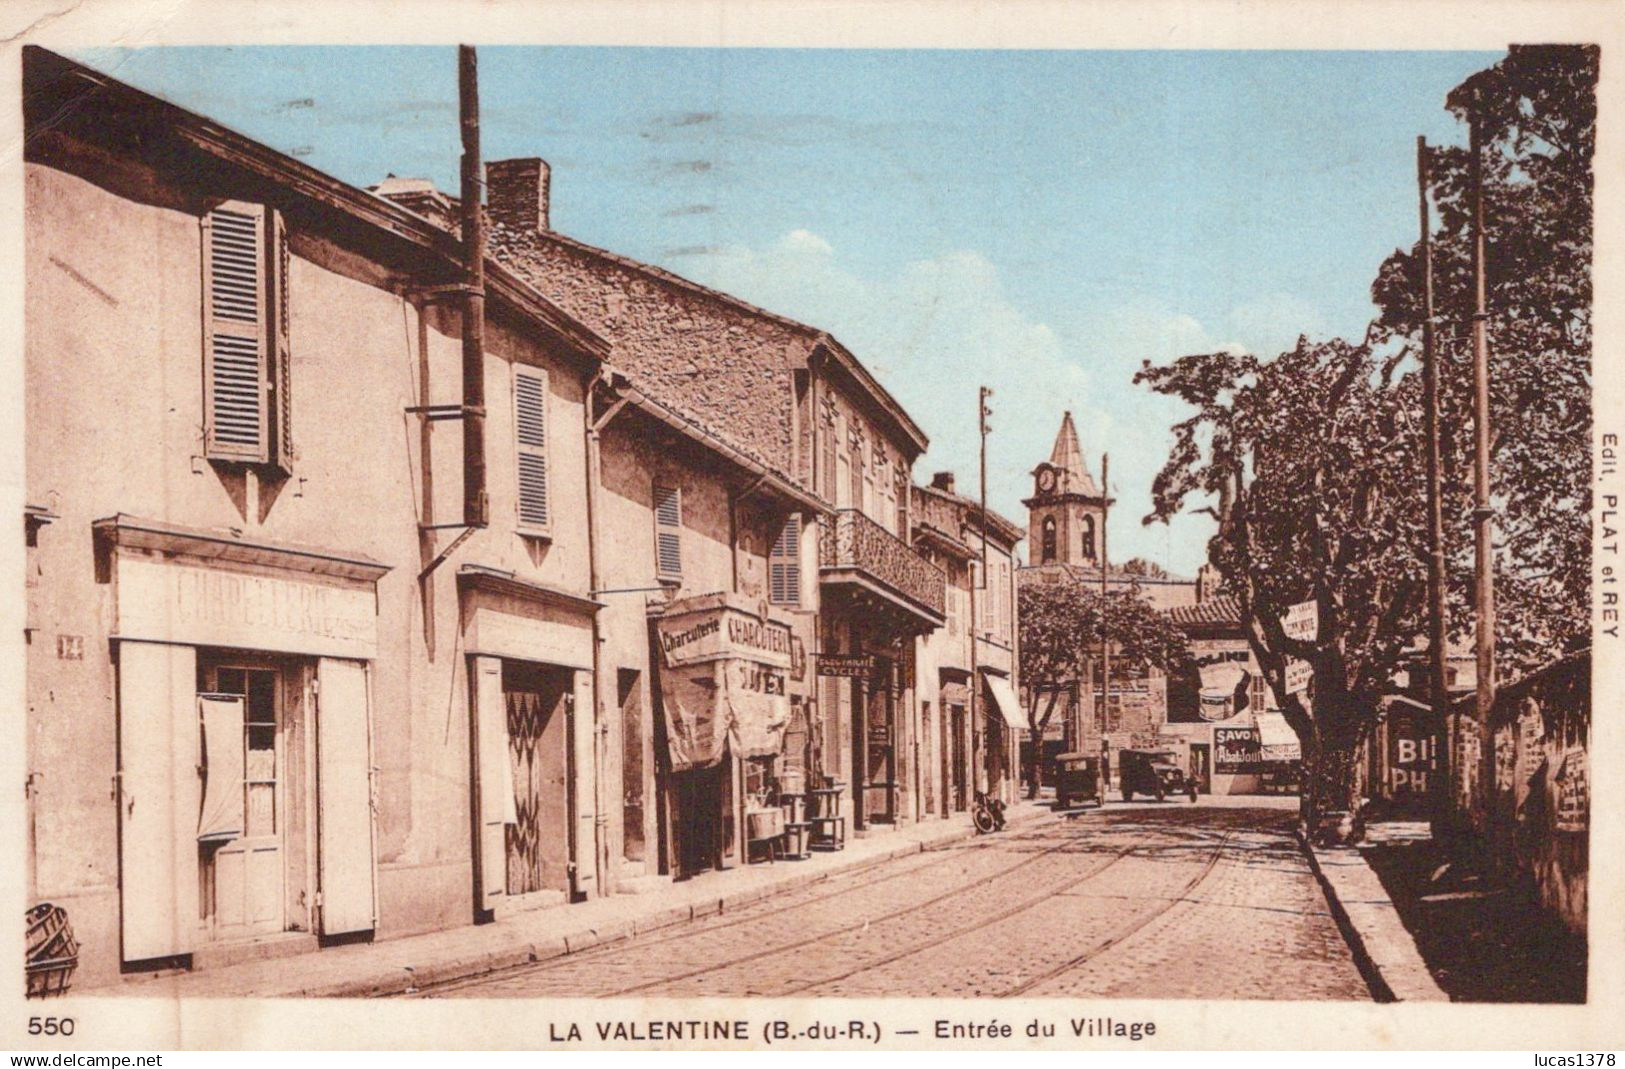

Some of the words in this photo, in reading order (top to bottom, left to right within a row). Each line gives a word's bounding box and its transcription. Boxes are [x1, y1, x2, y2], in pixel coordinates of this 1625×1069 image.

[662, 616, 721, 653] Charcuterie
[823, 668, 870, 677] CYCLES
[1216, 730, 1260, 744] SAVON
